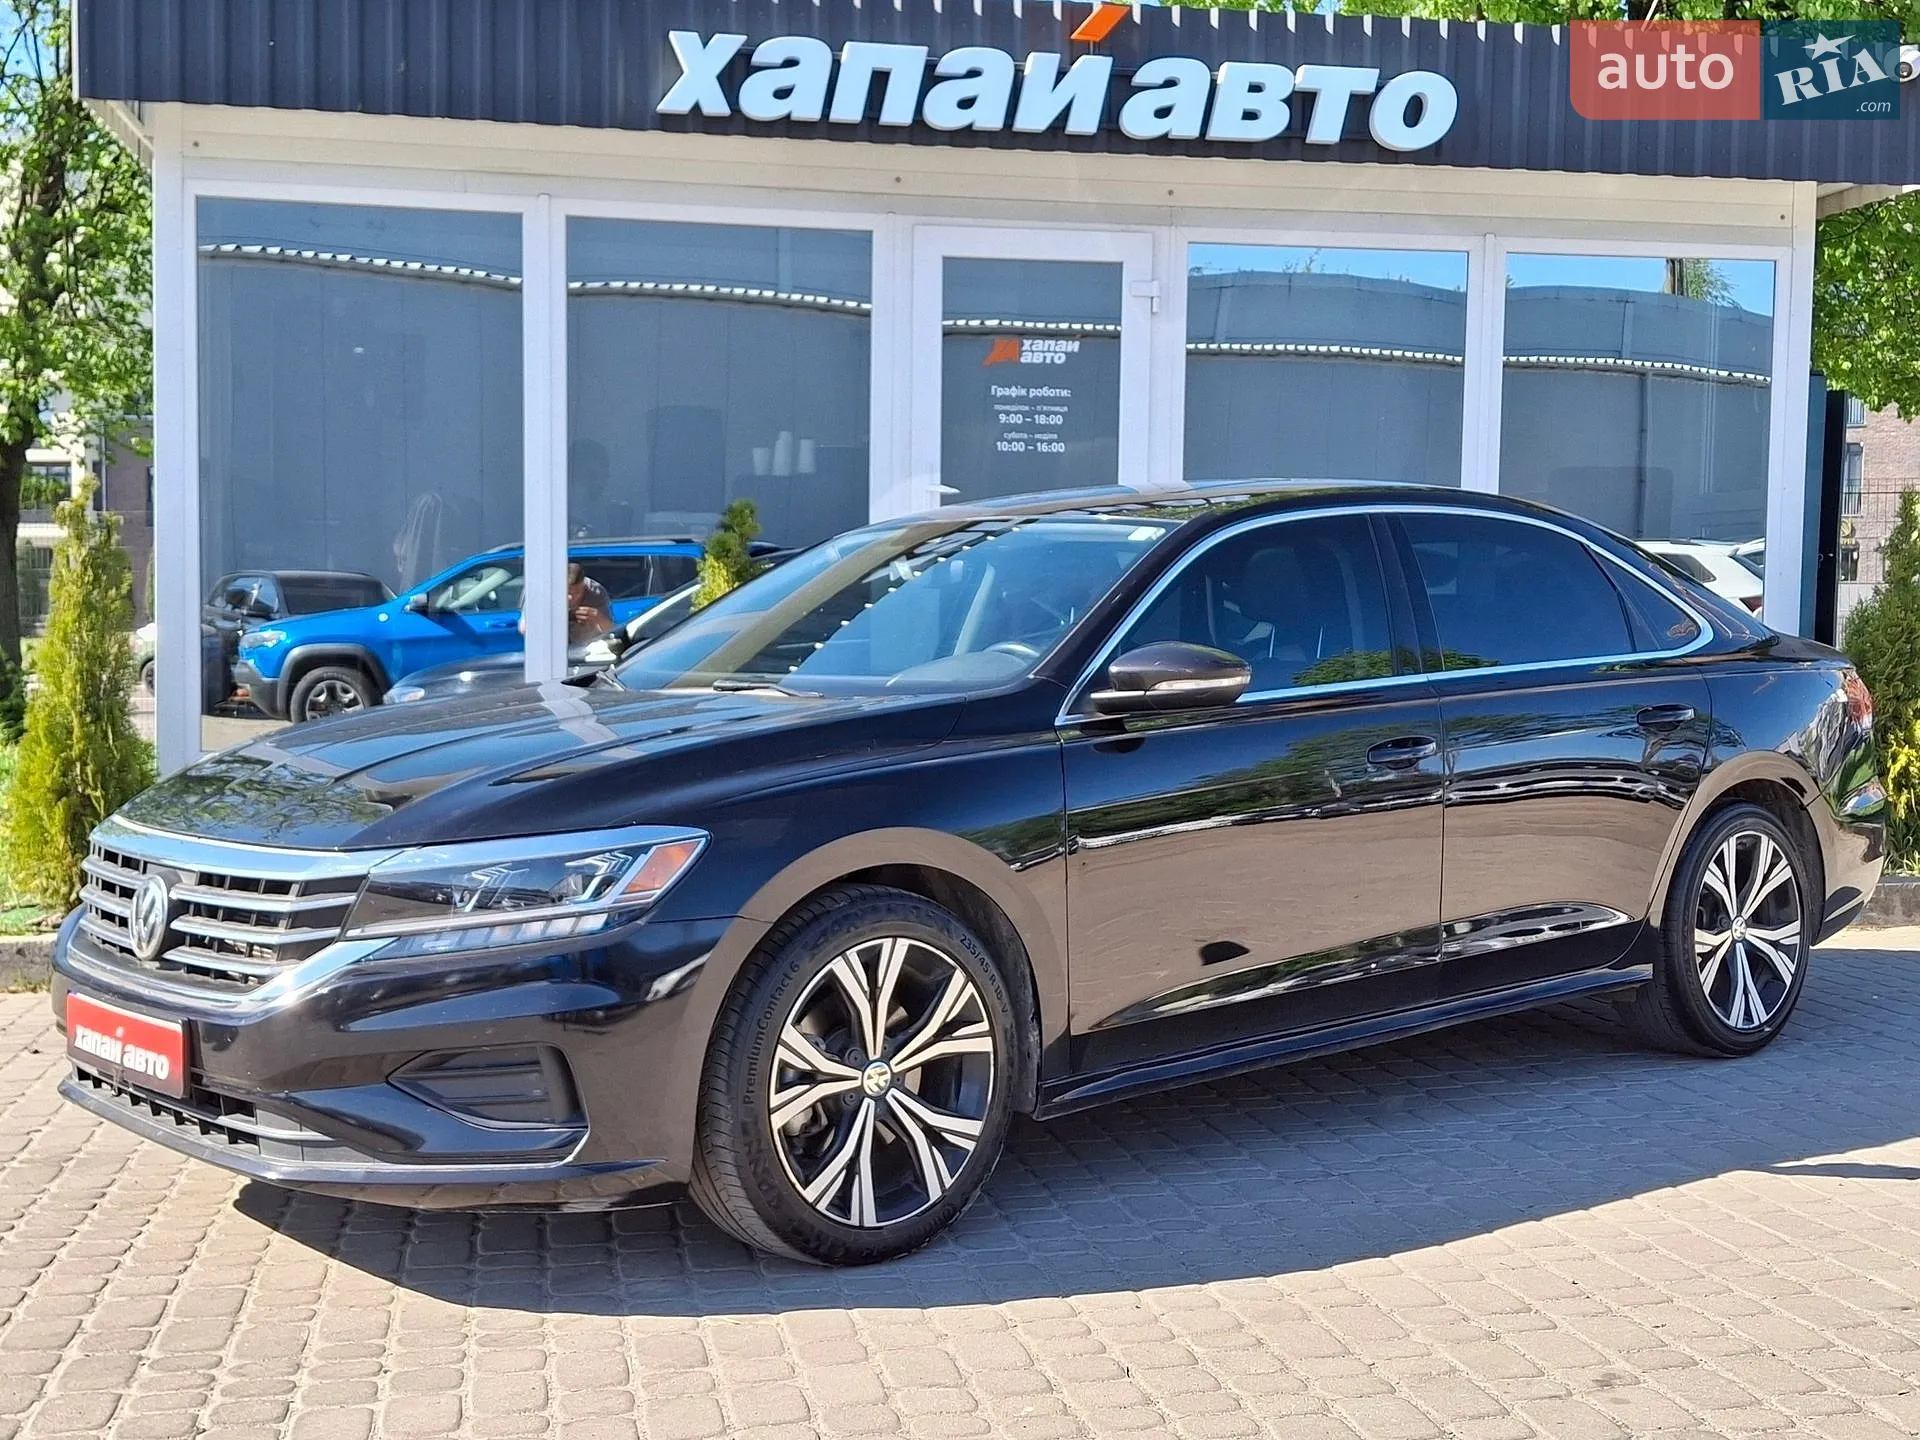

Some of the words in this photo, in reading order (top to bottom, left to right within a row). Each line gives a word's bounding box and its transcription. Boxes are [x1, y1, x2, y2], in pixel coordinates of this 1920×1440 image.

[656, 4, 1131, 136] хапай
[1118, 56, 1458, 153] авто
[1020, 351, 1066, 364] авто
[991, 385, 1027, 397] Графік
[1029, 385, 1072, 398] роботи:
[999, 413, 1024, 424] 9:00
[1034, 414, 1064, 424] 18:00
[996, 441, 1025, 452] 10:00
[1036, 442, 1065, 452] 16:00
[960, 933, 991, 973] 235/45
[743, 973, 793, 1105] PremiumContact
[790, 960, 800, 973] 6
[122, 1043, 170, 1080] авто
